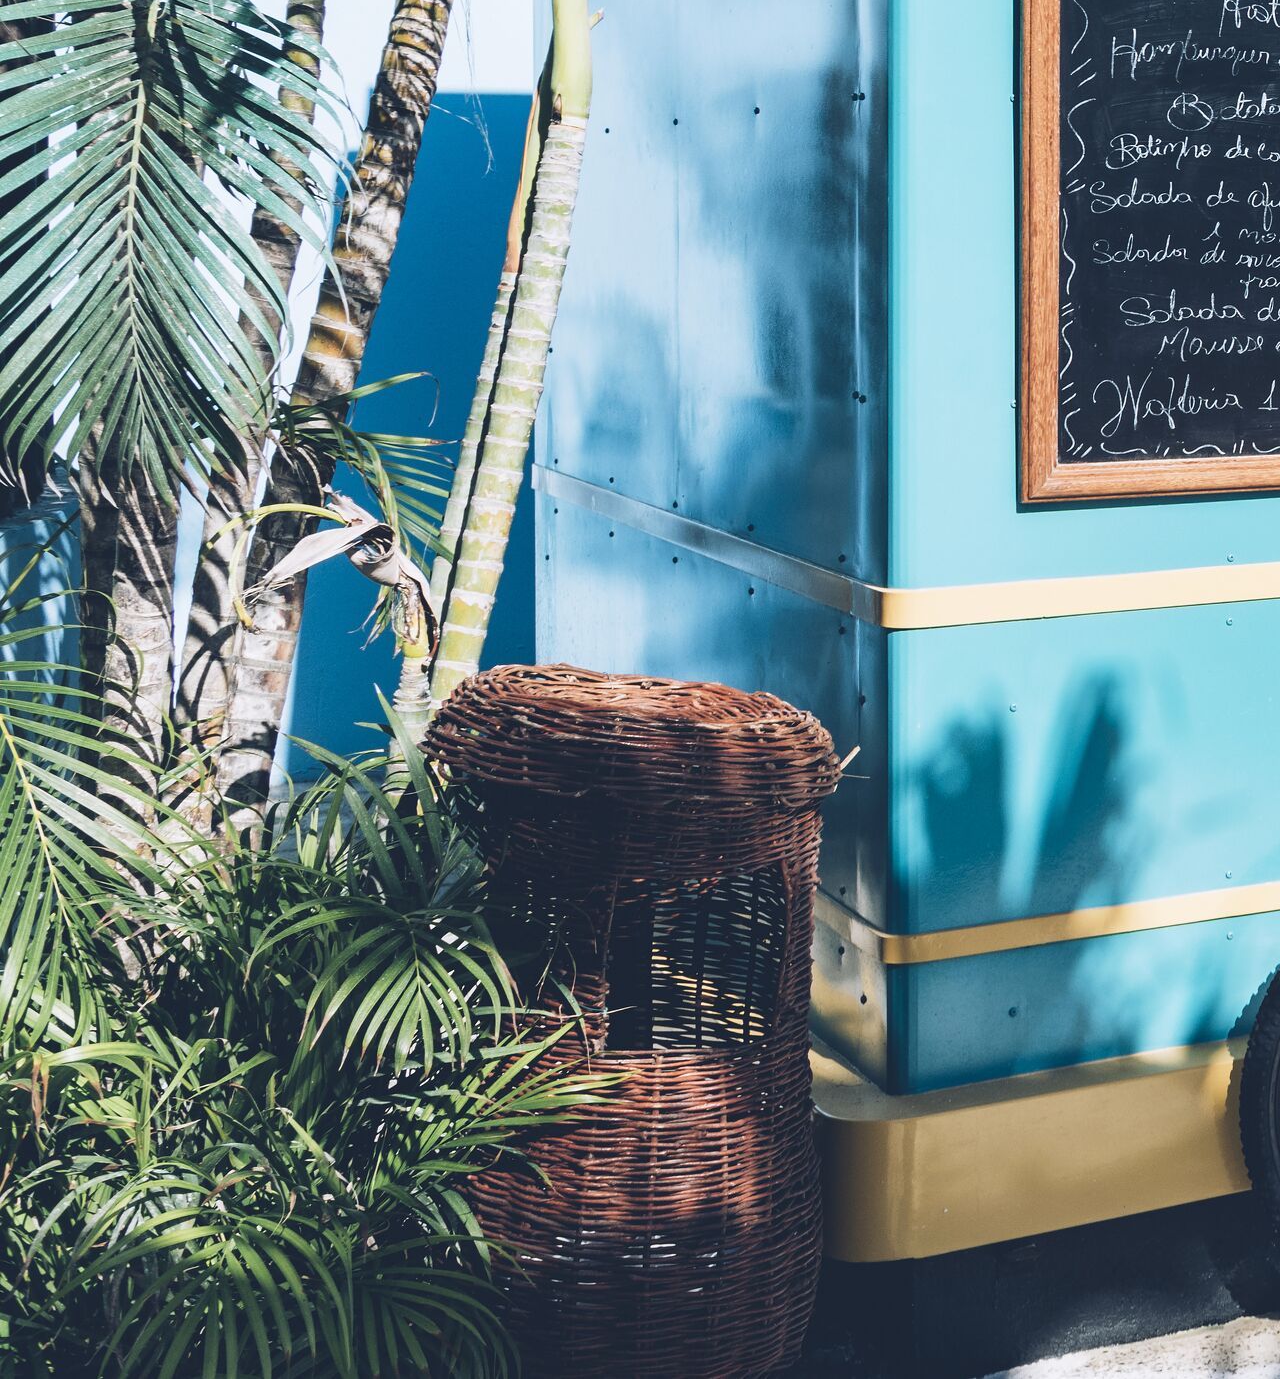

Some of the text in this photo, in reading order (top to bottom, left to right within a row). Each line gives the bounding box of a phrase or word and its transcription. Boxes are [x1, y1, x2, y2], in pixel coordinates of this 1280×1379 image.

[1089, 177, 1193, 214] Salada
[1206, 180, 1240, 208] de
[1092, 233, 1189, 265] Salada
[1199, 241, 1227, 265] de
[1119, 288, 1246, 327] Salada
[1157, 326, 1264, 363] Mousse
